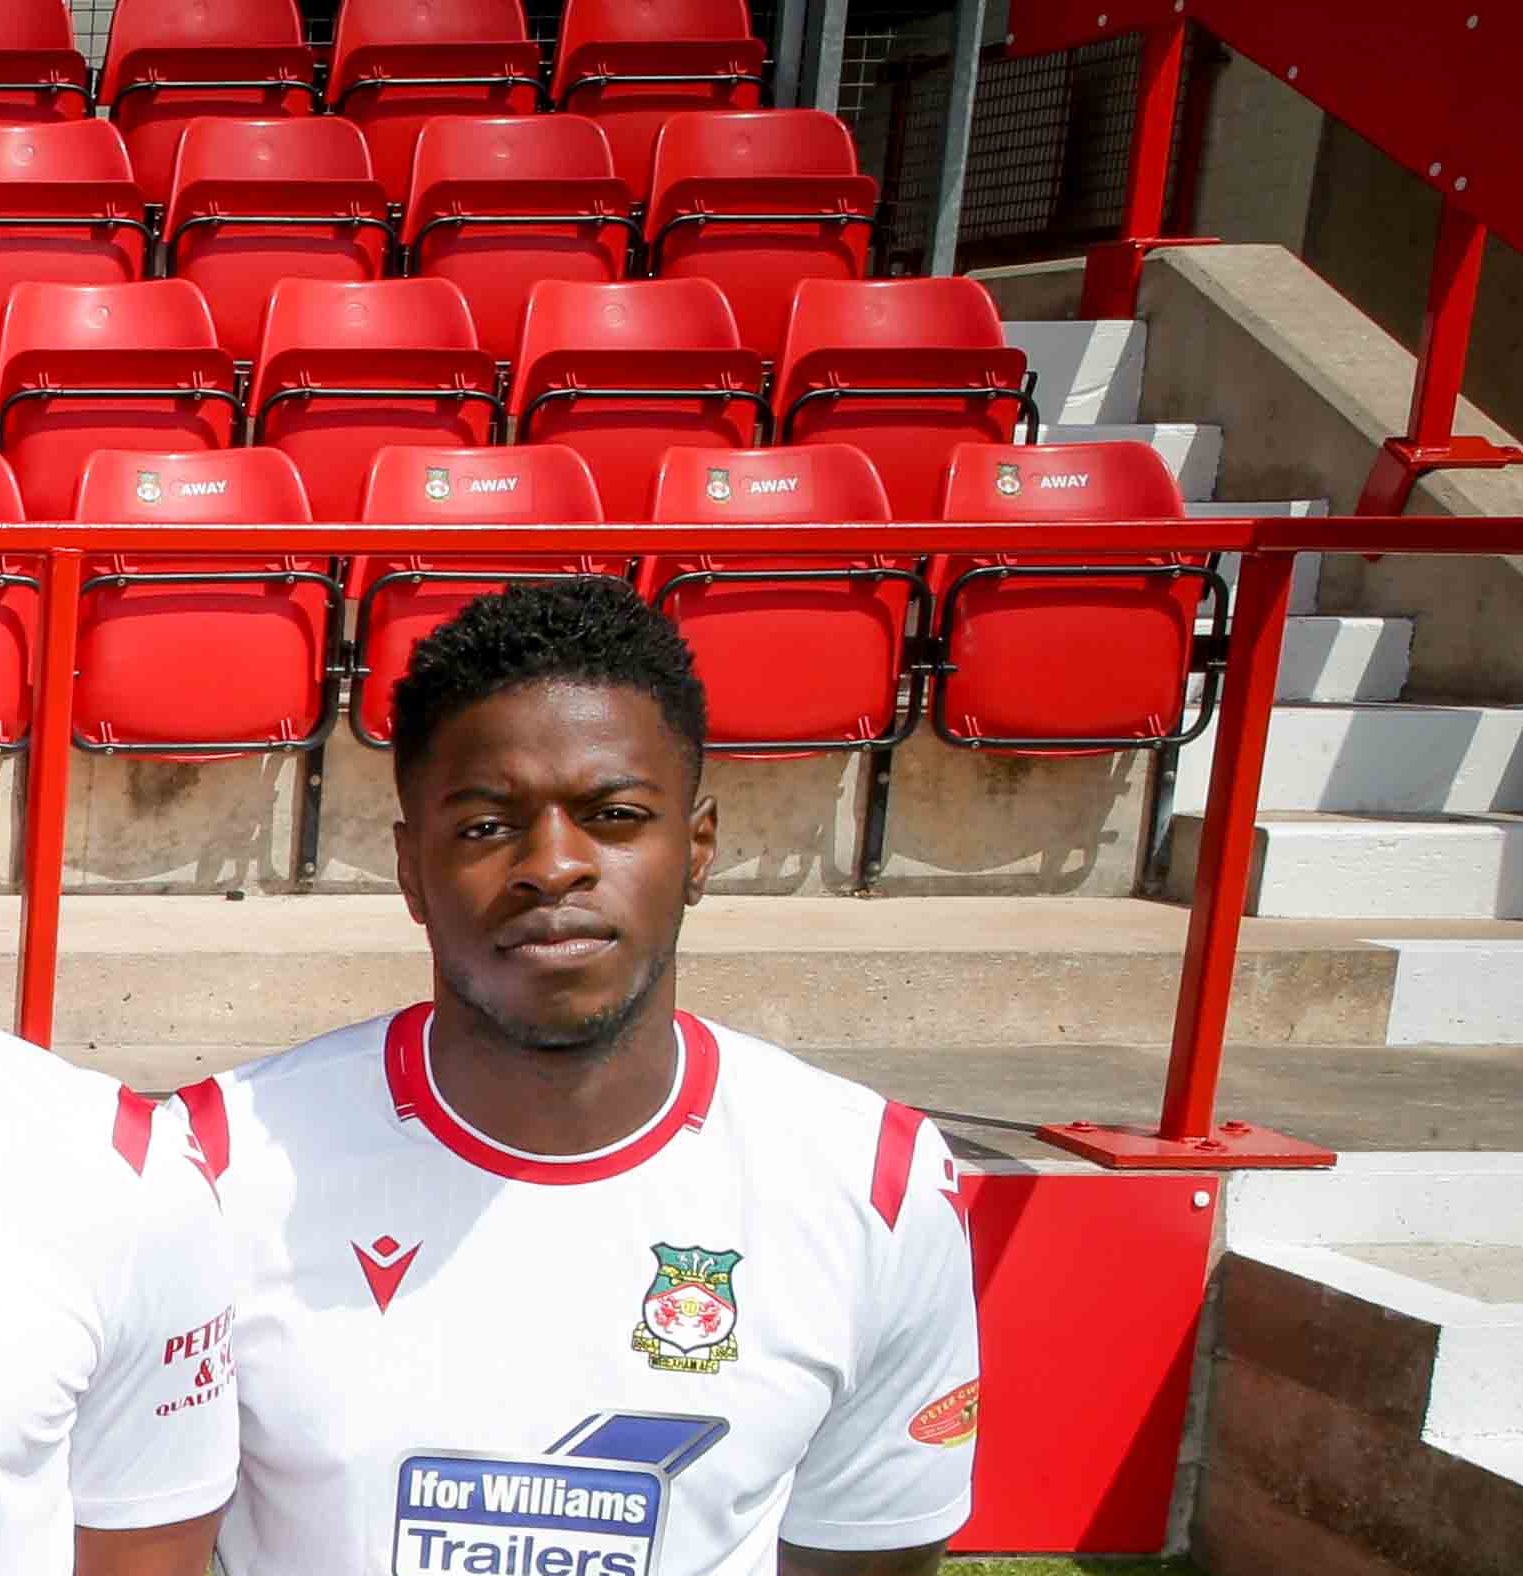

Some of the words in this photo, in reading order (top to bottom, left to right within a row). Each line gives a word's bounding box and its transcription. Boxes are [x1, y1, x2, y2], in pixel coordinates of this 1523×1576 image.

[180, 479, 228, 496] AWAY
[470, 477, 518, 493] AWAY
[749, 477, 798, 493] AWAY
[1039, 473, 1089, 489] AWAY
[194, 1358, 214, 1388] &
[408, 1468, 476, 1511] Ifor
[482, 1473, 648, 1525] Williams
